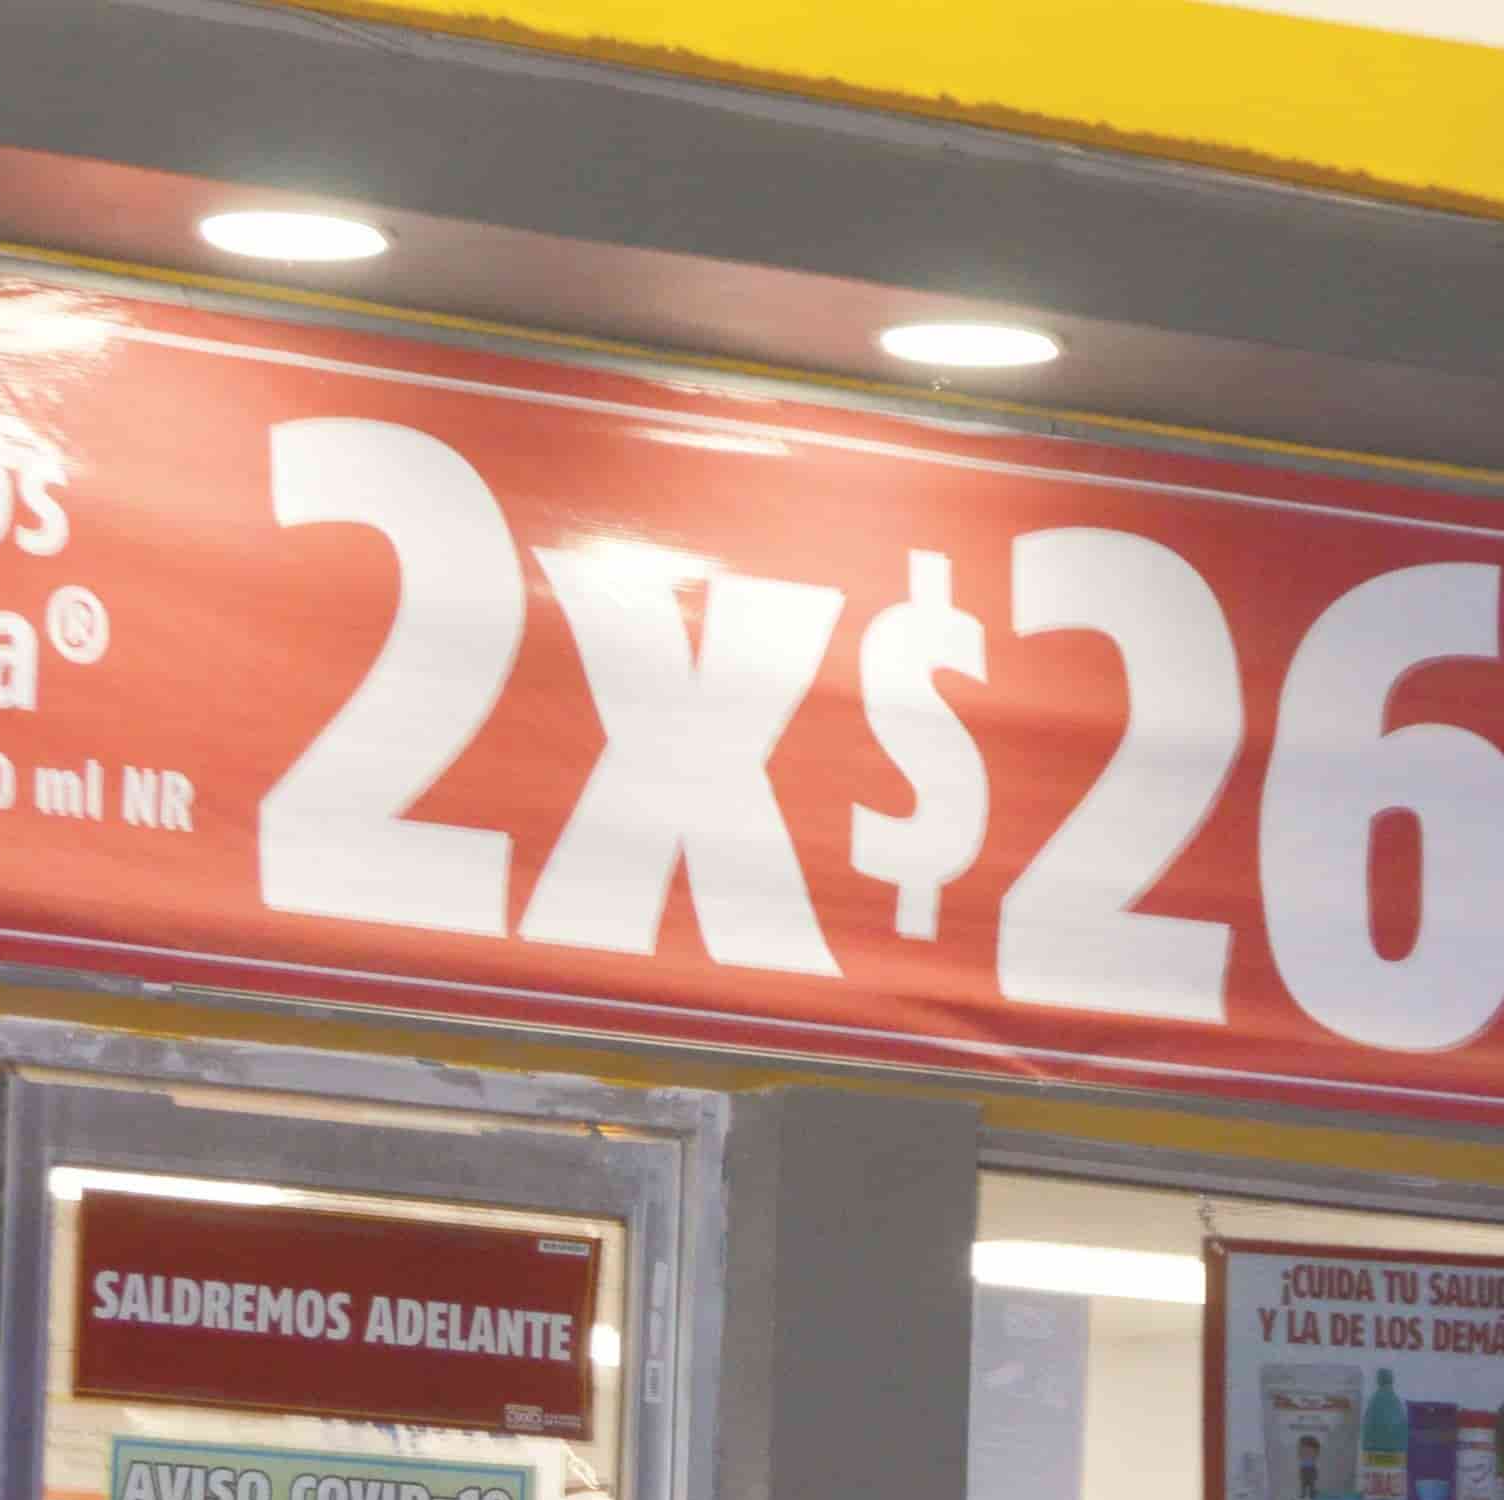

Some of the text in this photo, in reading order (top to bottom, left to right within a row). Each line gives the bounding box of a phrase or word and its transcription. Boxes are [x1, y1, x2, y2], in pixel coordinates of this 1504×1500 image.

[34, 758, 103, 822] ml
[122, 767, 196, 834] NR
[92, 1270, 573, 1362] SALDREMOS ADELANTE
[1383, 1269, 1419, 1304] TU
[1257, 1308, 1277, 1342] Y
[1286, 1310, 1321, 1345] LA
[1329, 1312, 1365, 1347] DE
[1374, 1316, 1424, 1351] LOS
